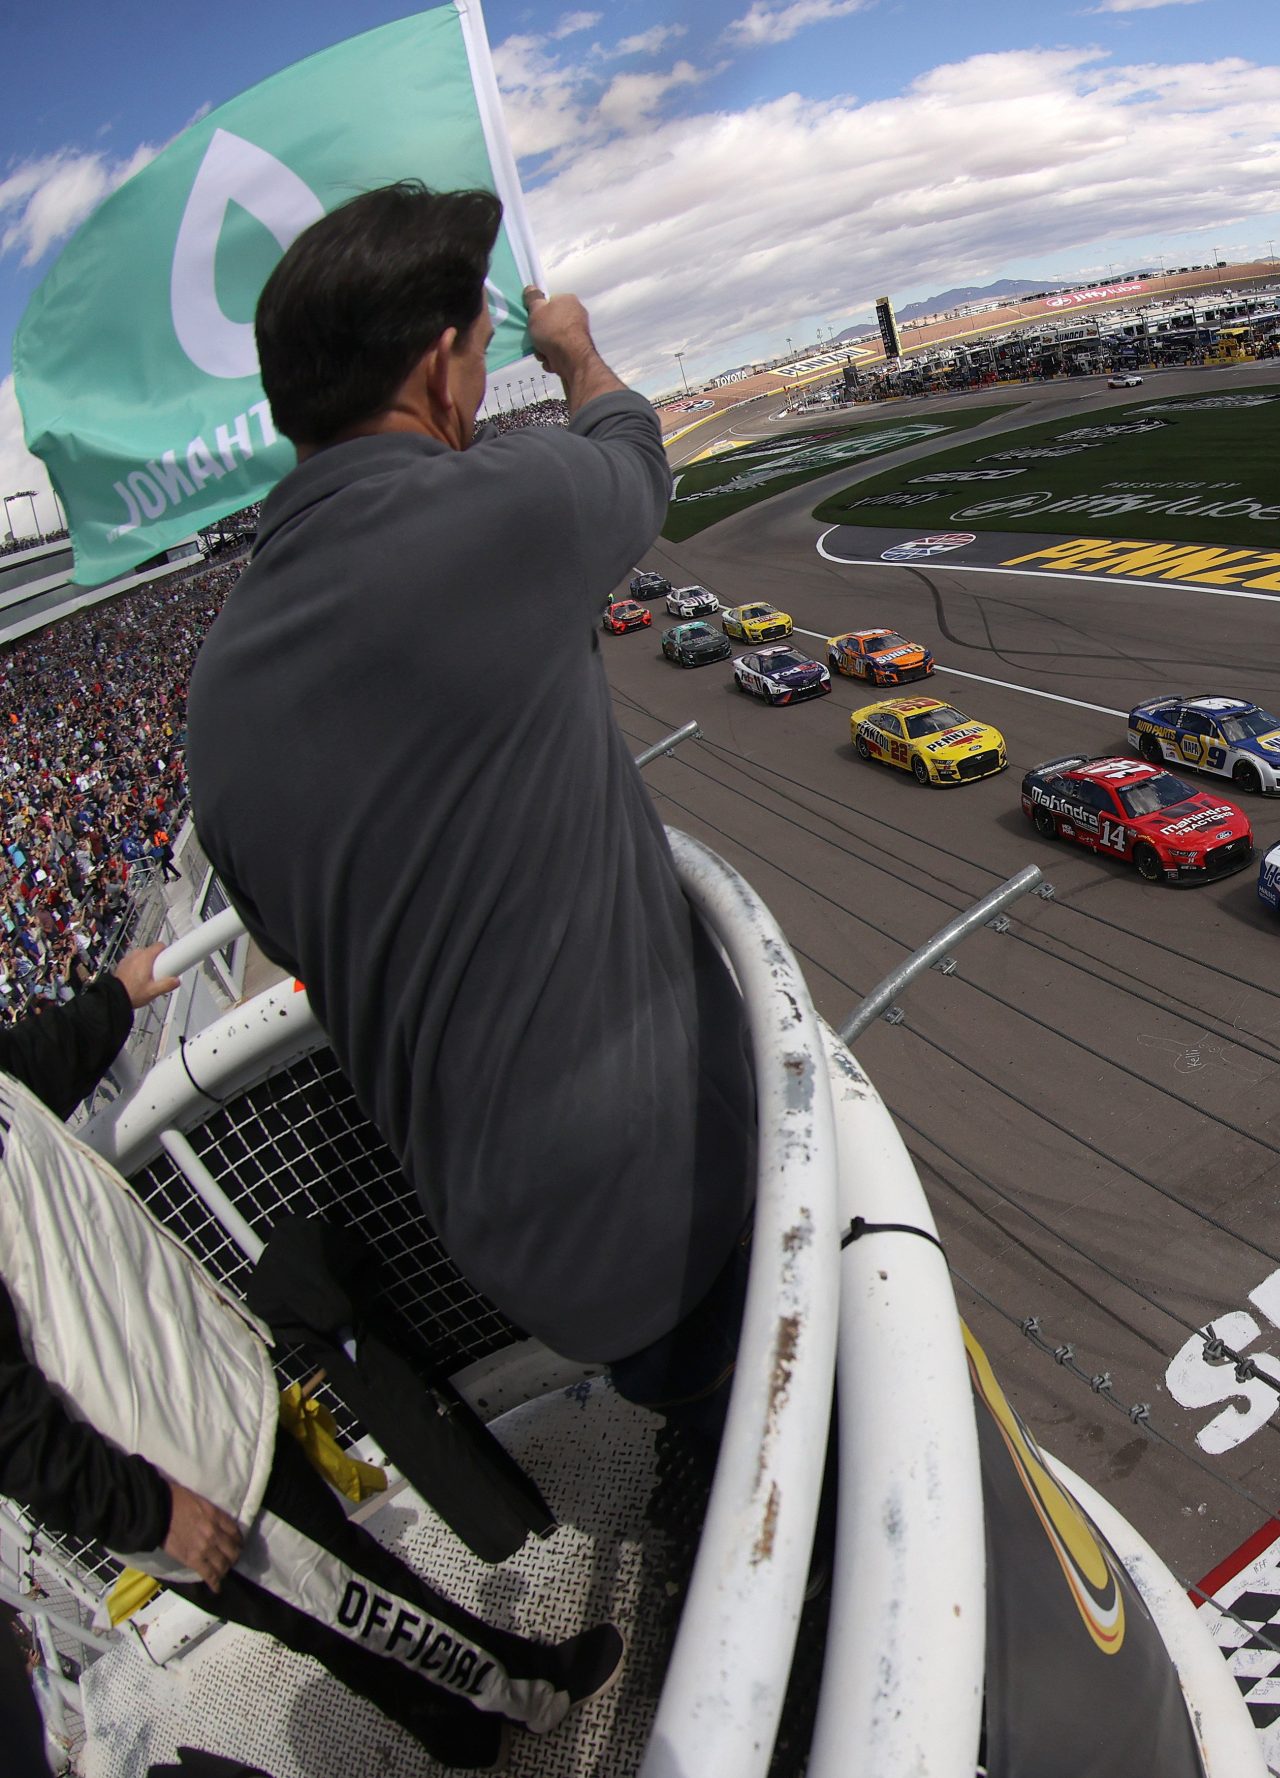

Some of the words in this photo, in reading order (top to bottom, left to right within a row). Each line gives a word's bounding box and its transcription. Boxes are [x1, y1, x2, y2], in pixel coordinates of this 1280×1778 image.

[1054, 330, 1084, 343] SUNOCO
[779, 348, 869, 377] PENNZOIL
[715, 370, 749, 389] TOYOTA
[907, 467, 1028, 483] GEICO
[1102, 481, 1207, 489] PRESENTED
[1208, 482, 1242, 490] BY
[772, 662, 818, 680] FedEx
[856, 719, 890, 752] PENNZOIL
[926, 725, 988, 752] PENNZOIL
[1136, 719, 1152, 734] AUTO
[1151, 725, 1177, 739] PARTS
[890, 739, 909, 764] 22
[1183, 739, 1199, 756] NAPA
[1207, 747, 1226, 770] 9
[1031, 786, 1100, 826] Mahindra
[1160, 805, 1232, 836] Mahindra
[1176, 811, 1234, 837] TRACTORS
[1100, 820, 1125, 853] 14
[337, 1580, 496, 1695] OFFICIAL
